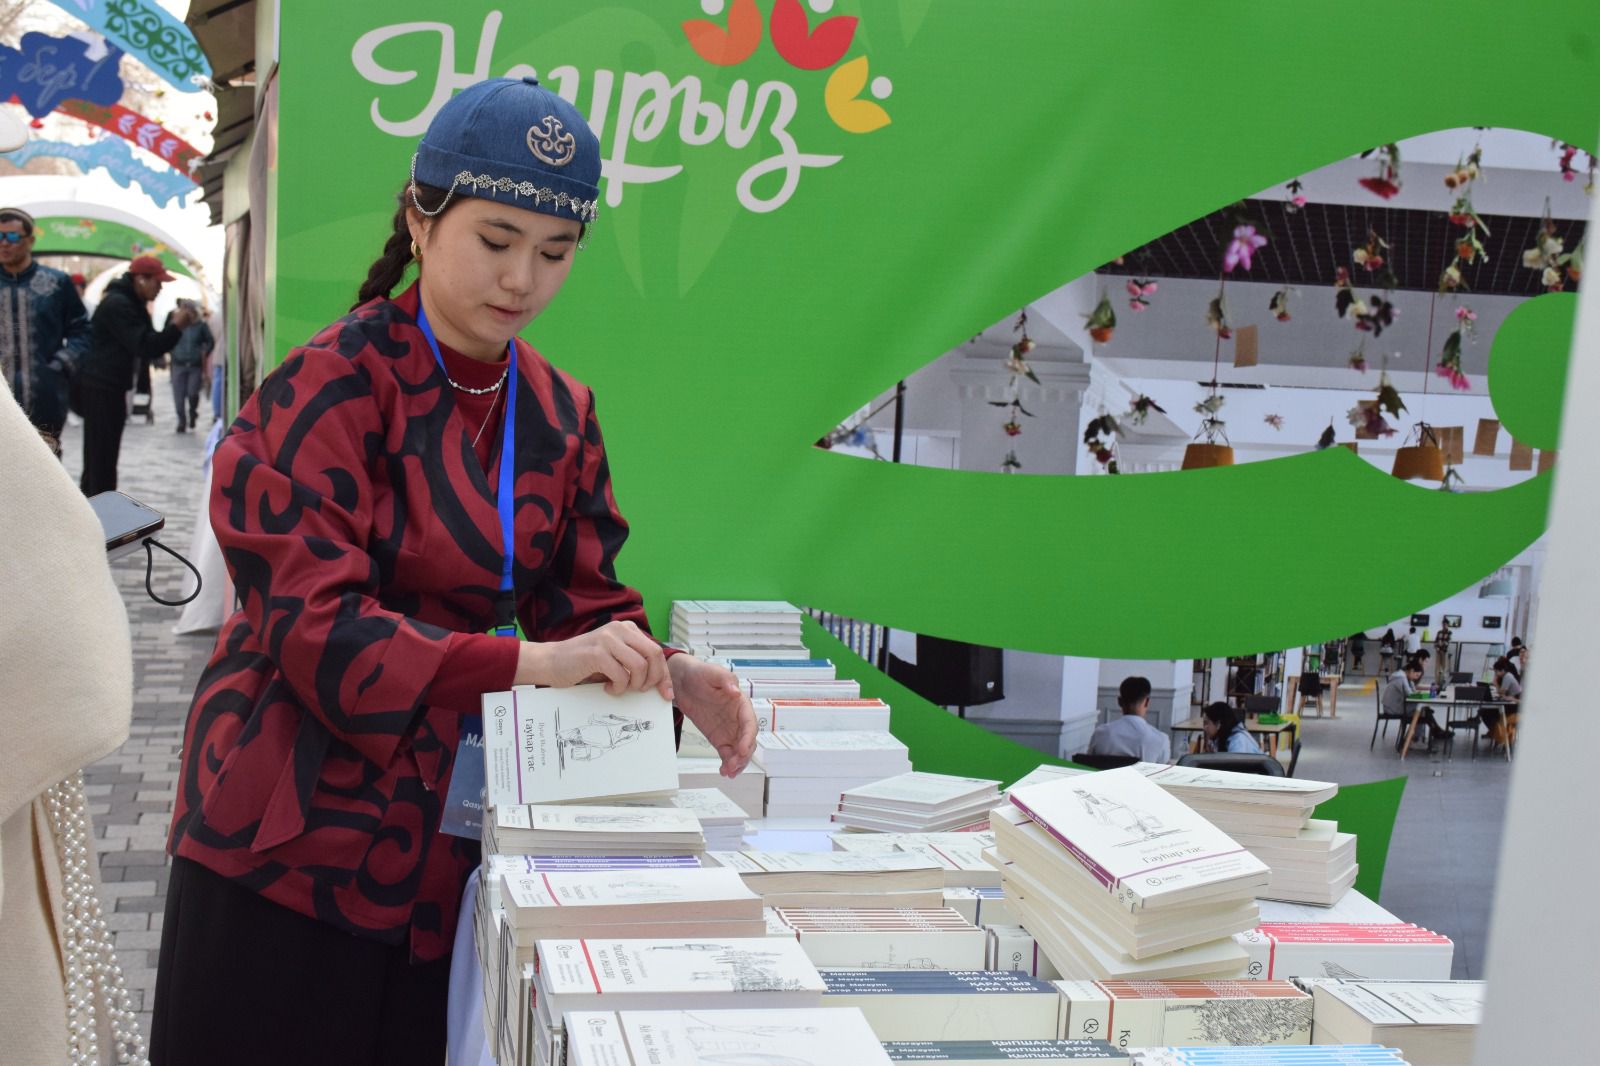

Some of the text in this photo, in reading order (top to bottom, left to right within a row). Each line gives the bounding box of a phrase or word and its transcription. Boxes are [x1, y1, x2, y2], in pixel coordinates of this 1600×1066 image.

[351, 9, 844, 214] Нурыз
[526, 755, 536, 773] тас
[462, 799, 484, 811] Qasy
